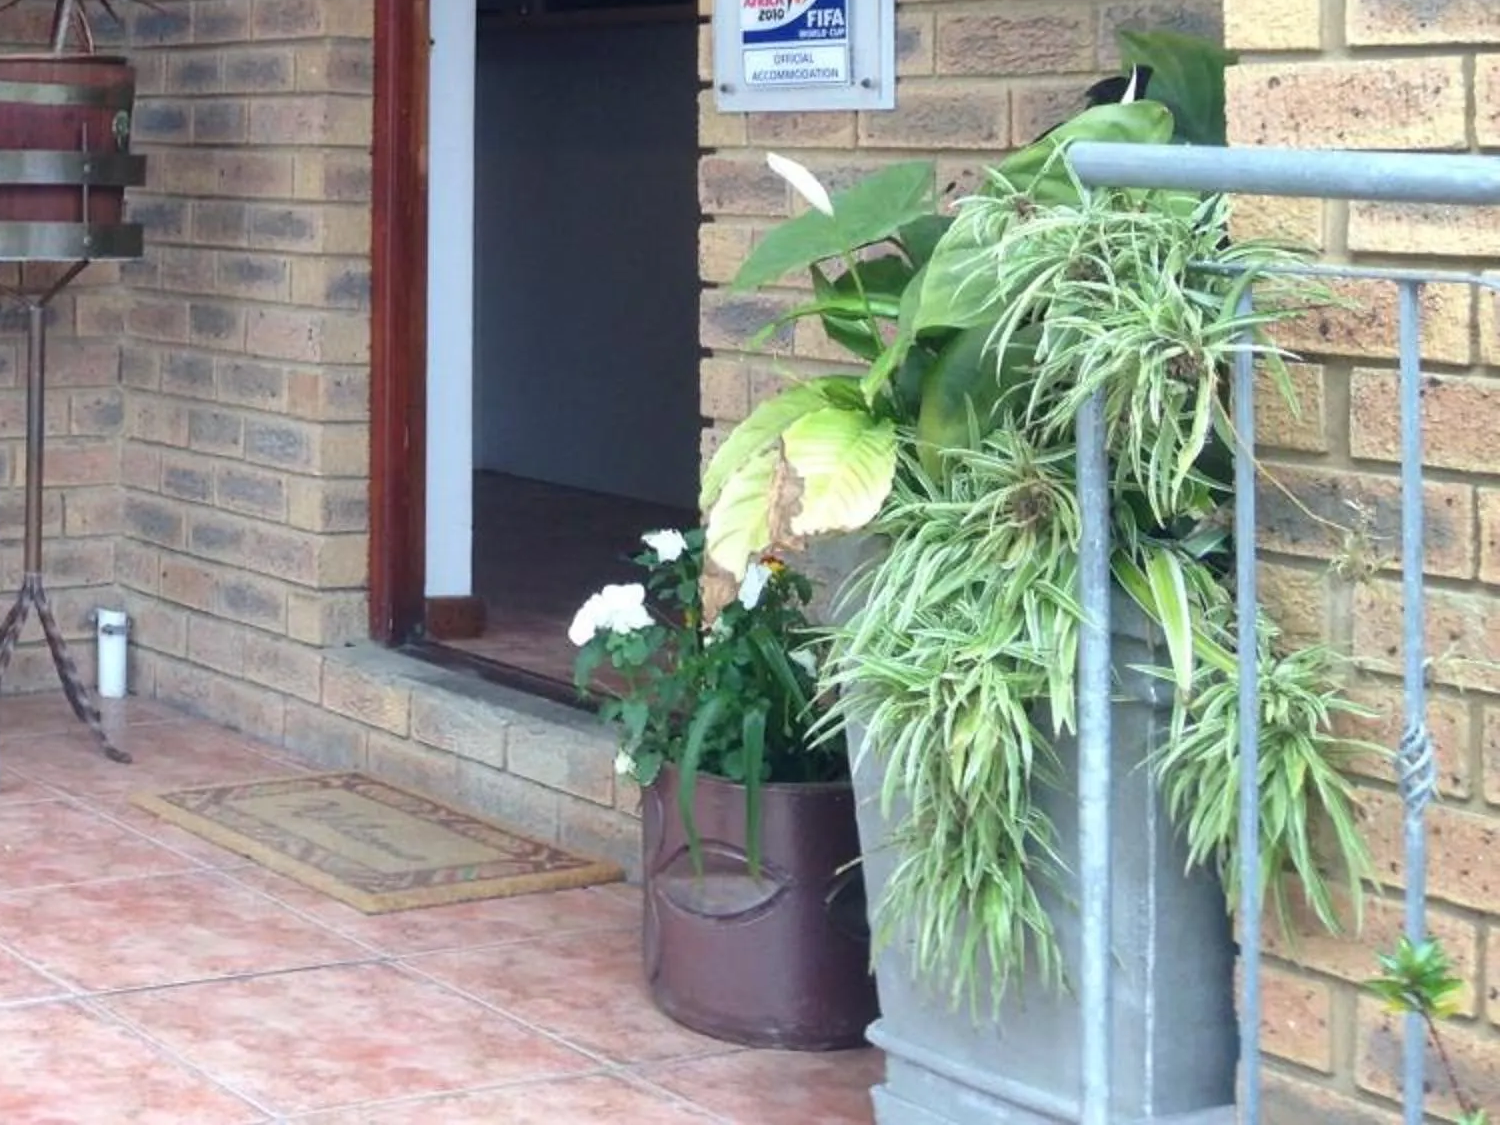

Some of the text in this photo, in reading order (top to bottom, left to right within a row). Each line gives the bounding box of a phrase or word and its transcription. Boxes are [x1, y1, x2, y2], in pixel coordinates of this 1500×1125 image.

[757, 9, 785, 22] 2010
[807, 7, 845, 27] FIFA
[799, 28, 845, 38] WORLD CUP
[773, 52, 814, 64] OFFICIAL
[752, 67, 840, 80] ACCOMMODATION
